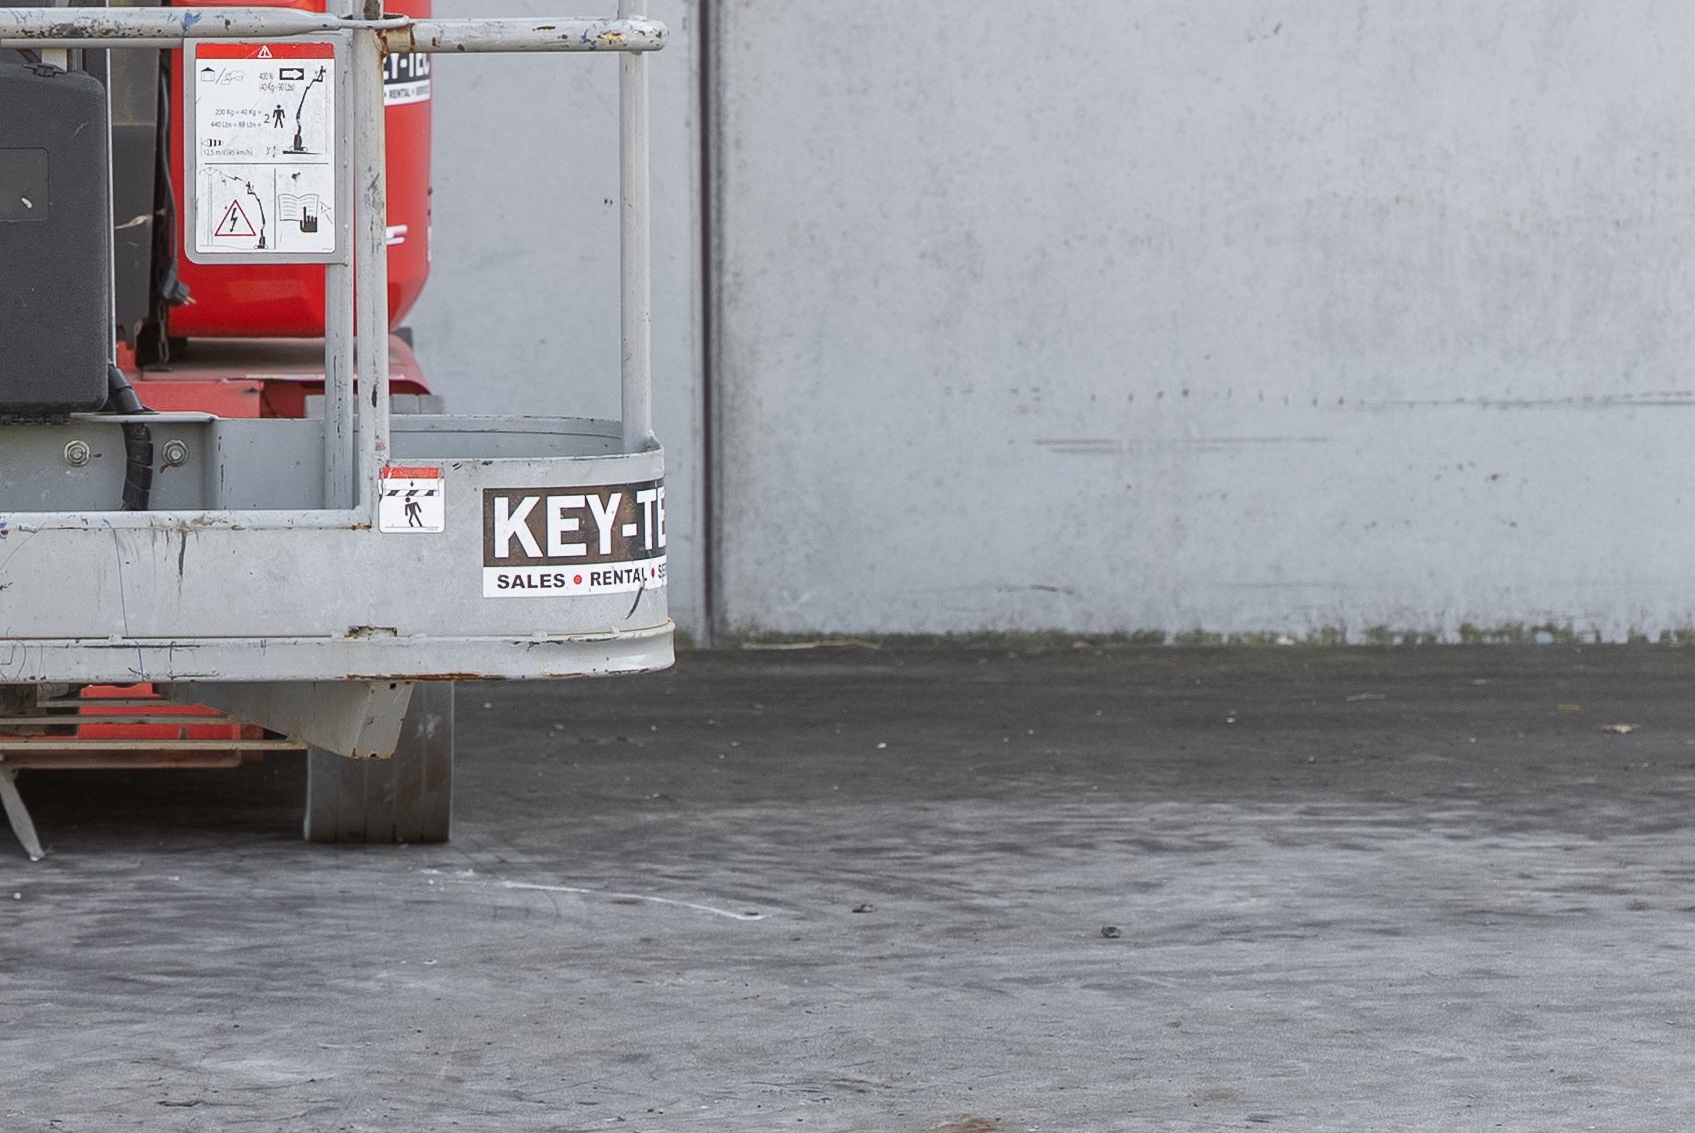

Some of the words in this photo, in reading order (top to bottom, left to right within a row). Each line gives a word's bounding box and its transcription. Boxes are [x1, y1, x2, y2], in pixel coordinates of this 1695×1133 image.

[263, 113, 270, 124] 2
[497, 573, 566, 589] SALES
[590, 567, 648, 587] RENTAL
